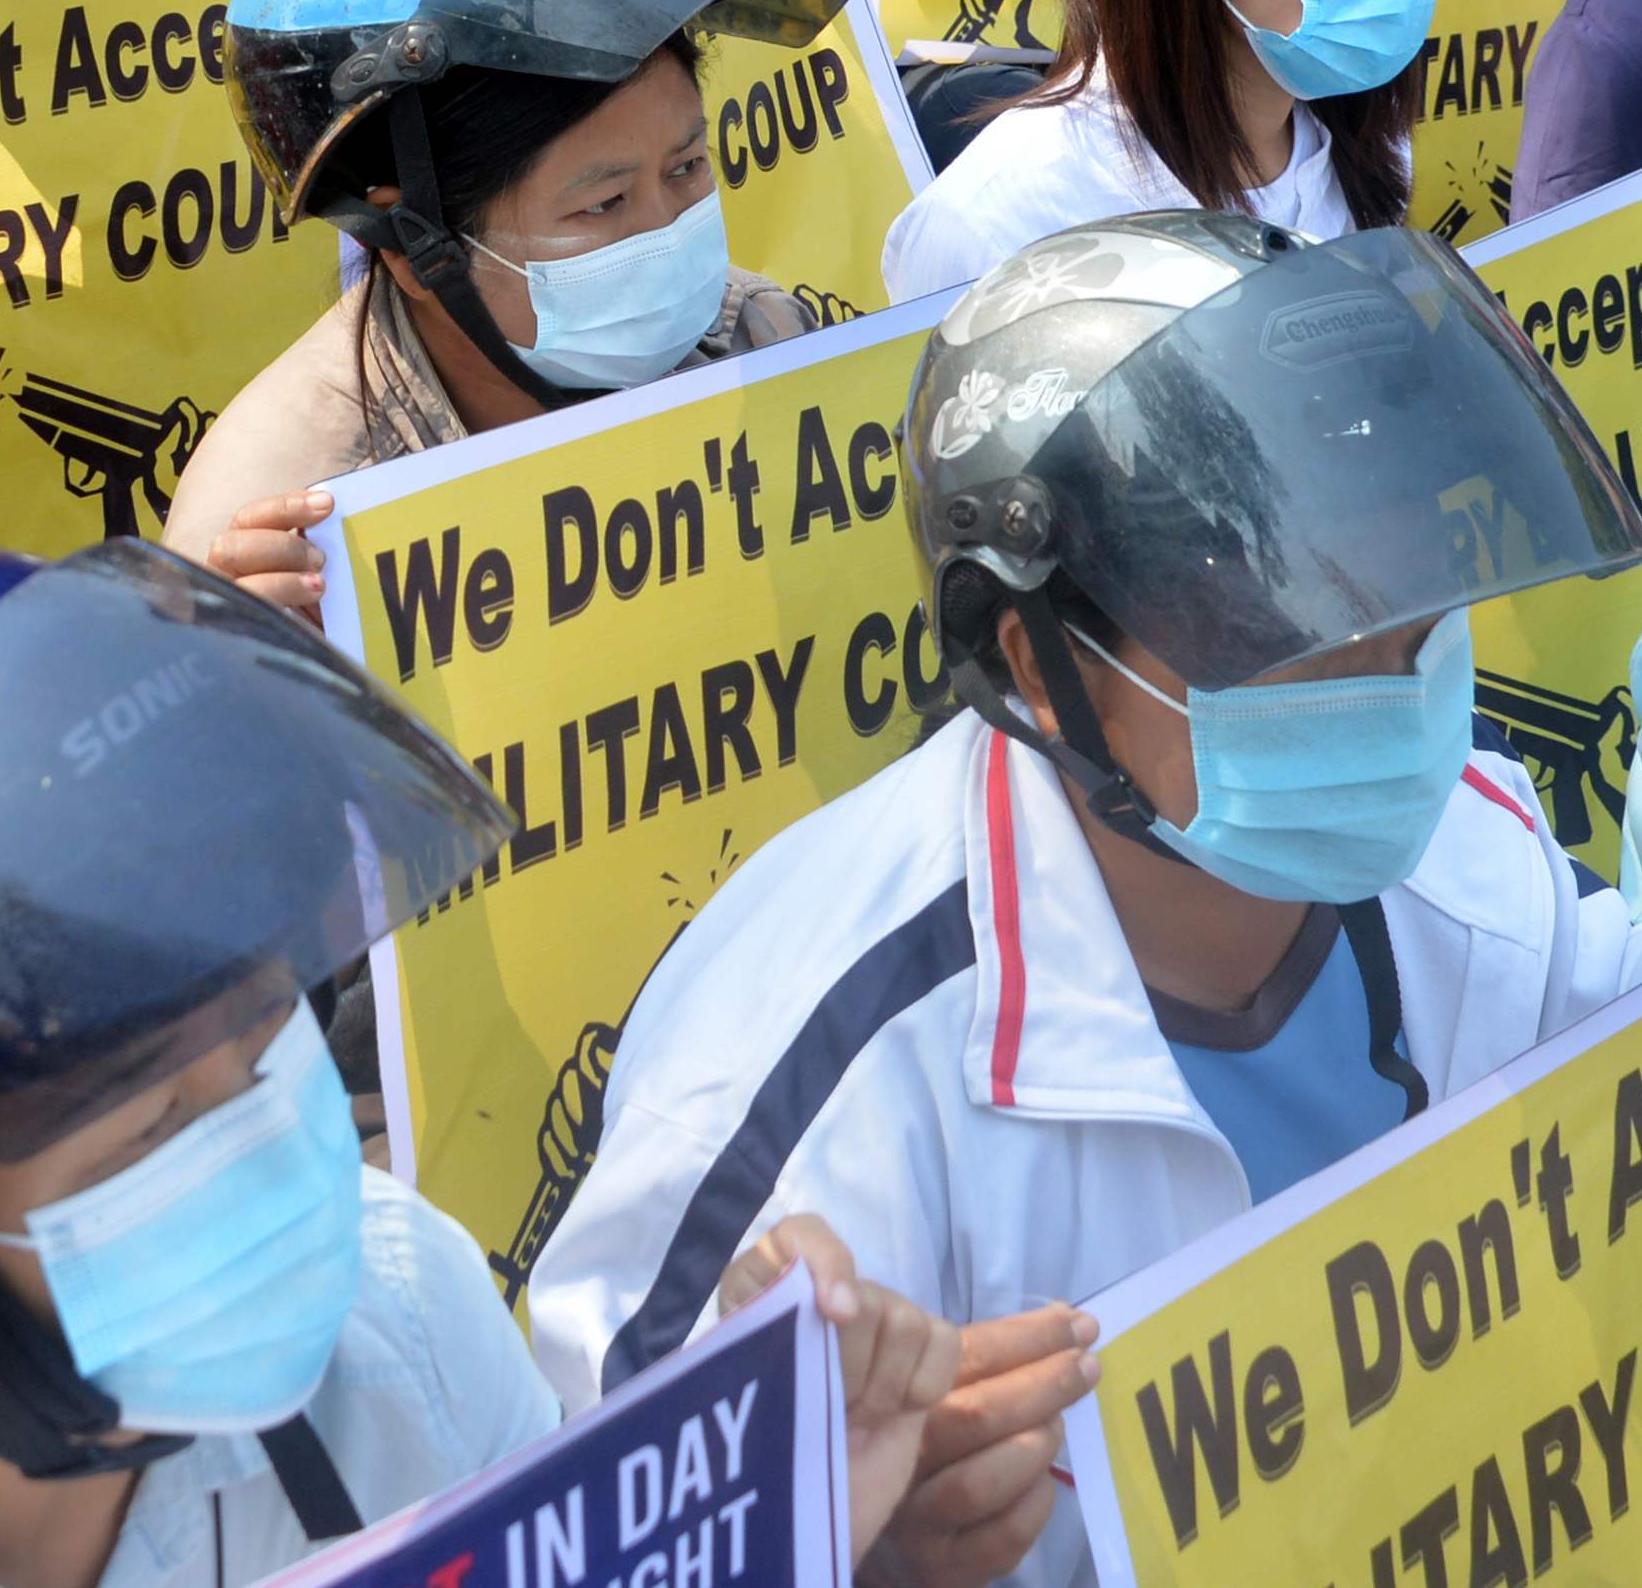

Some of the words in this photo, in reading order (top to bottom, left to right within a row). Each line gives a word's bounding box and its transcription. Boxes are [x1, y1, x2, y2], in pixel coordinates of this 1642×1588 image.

[50, 0, 228, 118] Acce
[715, 46, 850, 189] COUP
[1420, 19, 1540, 123] TARY
[106, 160, 293, 282] COU
[374, 524, 516, 683] We
[543, 430, 768, 627] Don't
[60, 646, 220, 779] SONIC
[842, 595, 952, 737] CO
[1134, 1326, 1306, 1554] We
[1324, 1122, 1582, 1430] Don't
[505, 1484, 587, 1588] IN
[617, 1377, 760, 1553] DAY
[1325, 1345, 1640, 1588] TARY
[607, 1488, 759, 1588] GHT
